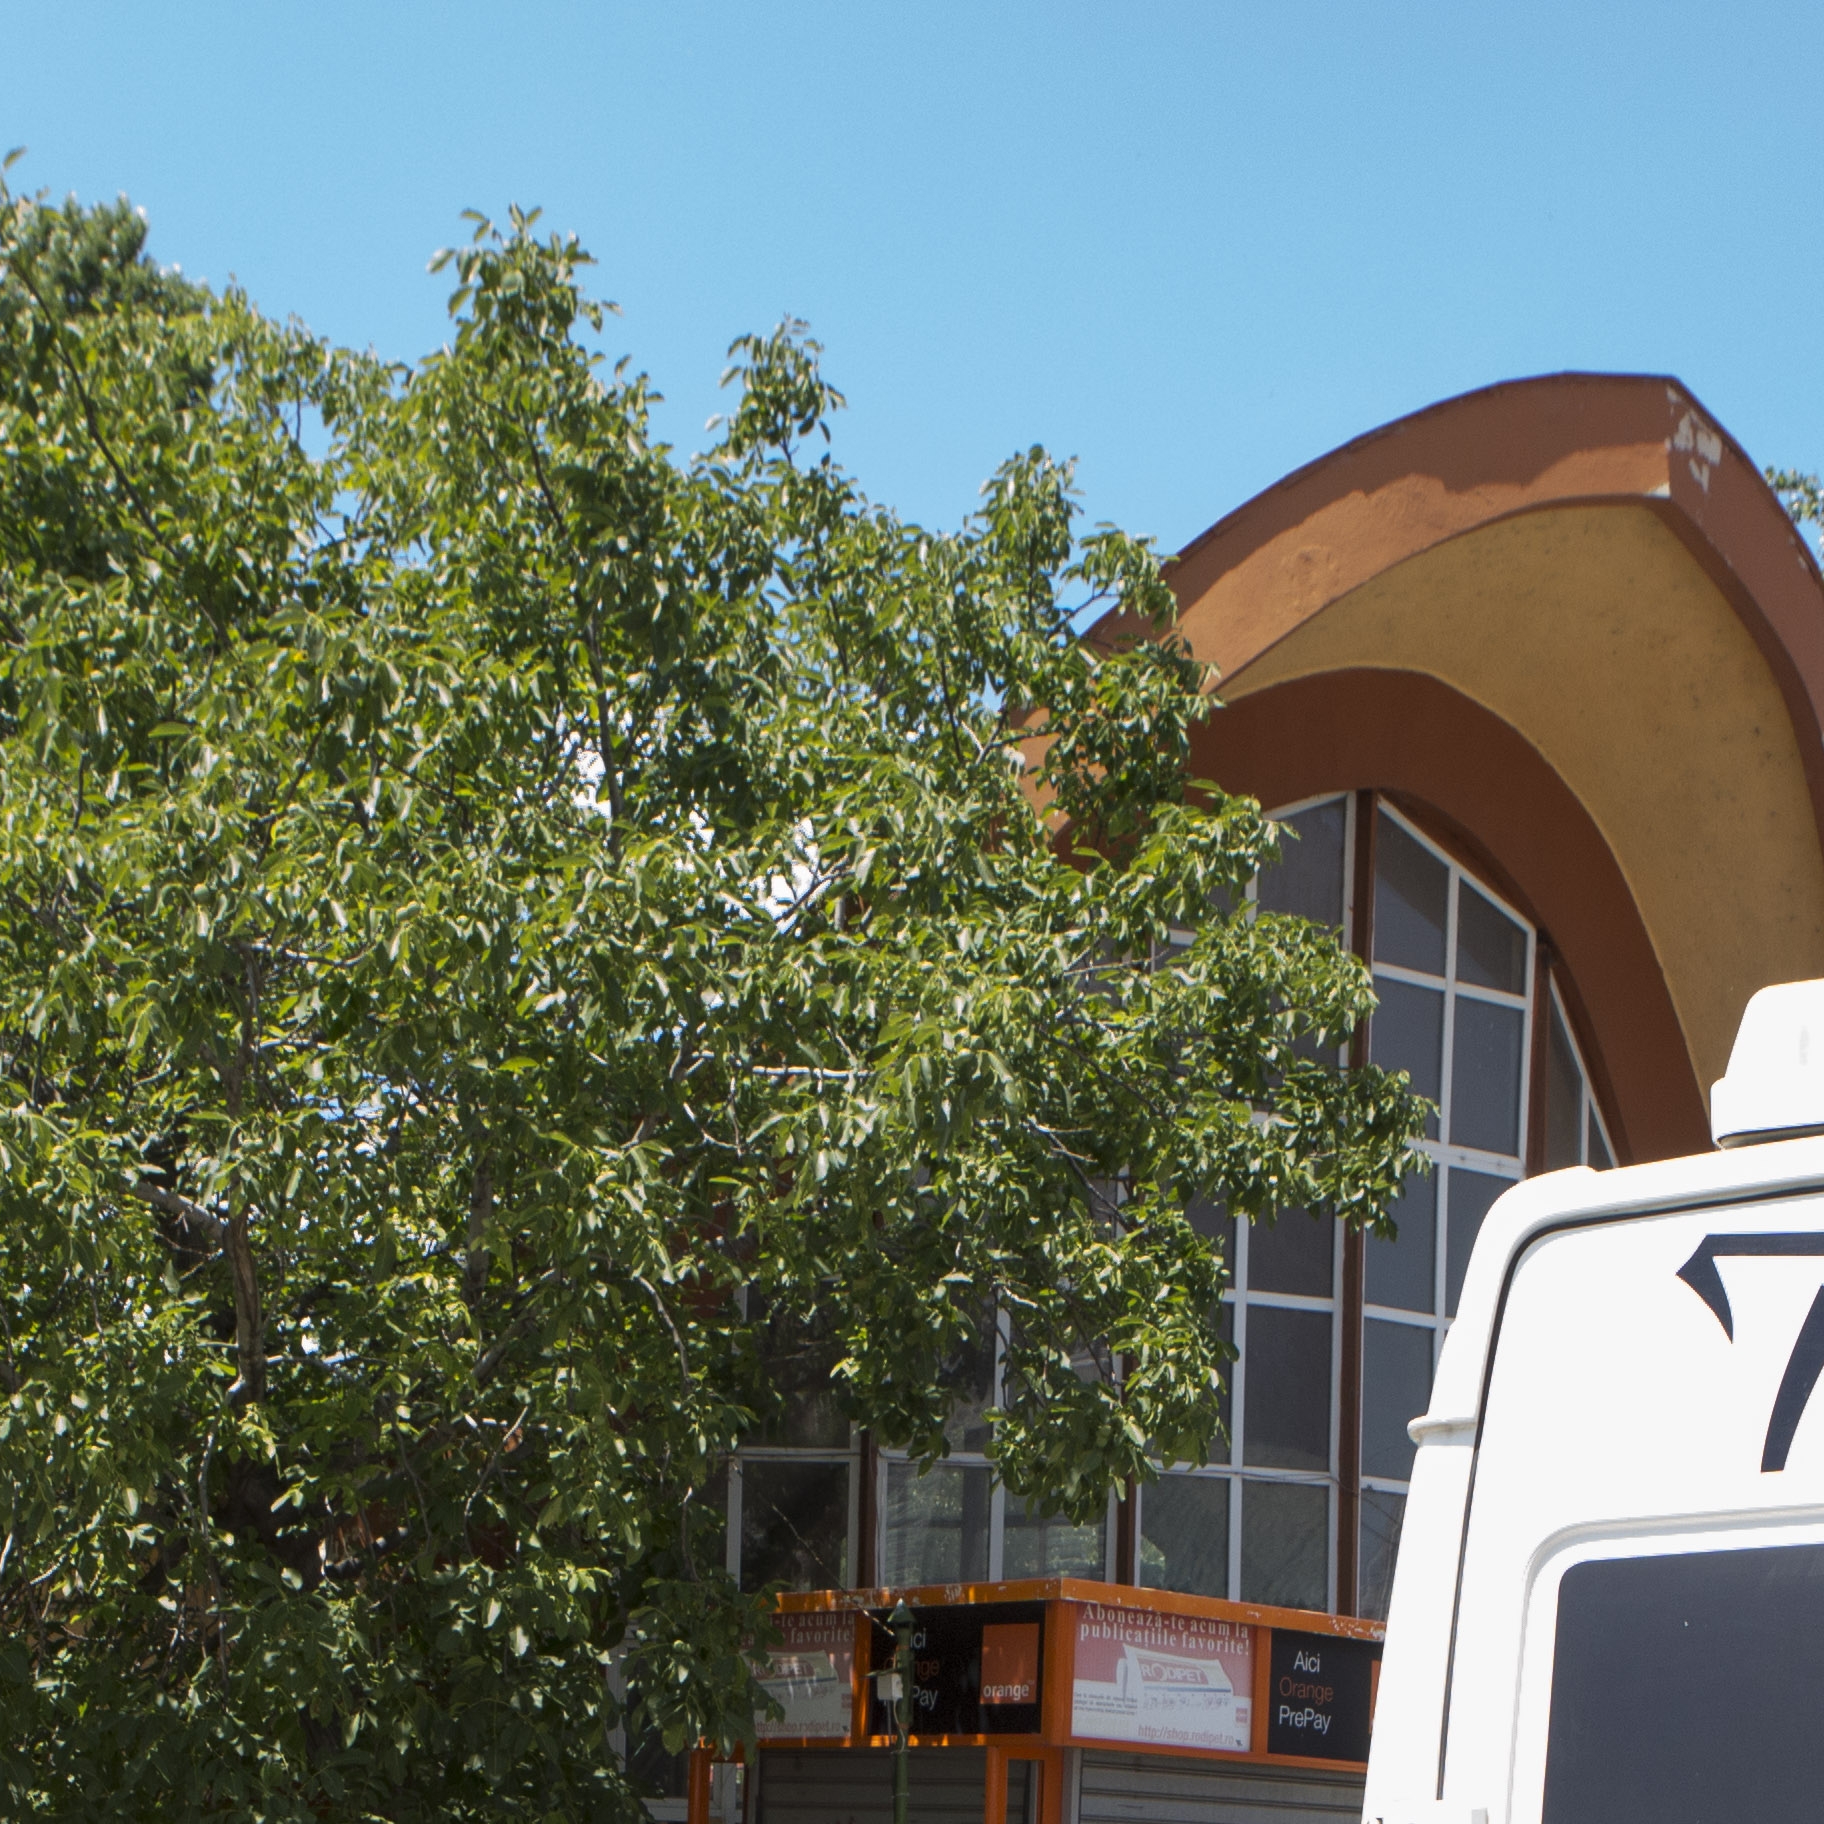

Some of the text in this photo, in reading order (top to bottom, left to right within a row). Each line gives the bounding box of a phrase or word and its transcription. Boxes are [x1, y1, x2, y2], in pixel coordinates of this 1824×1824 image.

[1190, 1621, 1230, 1636] acum
[1235, 1622, 1249, 1639] la
[1182, 1631, 1250, 1656] favorite!
[1140, 1663, 1203, 1683] RODIPET
[1293, 1651, 1321, 1673] Aici
[983, 1683, 1030, 1701] orange
[1279, 1677, 1334, 1706] Orange
[1278, 1705, 1332, 1736] PrePay
